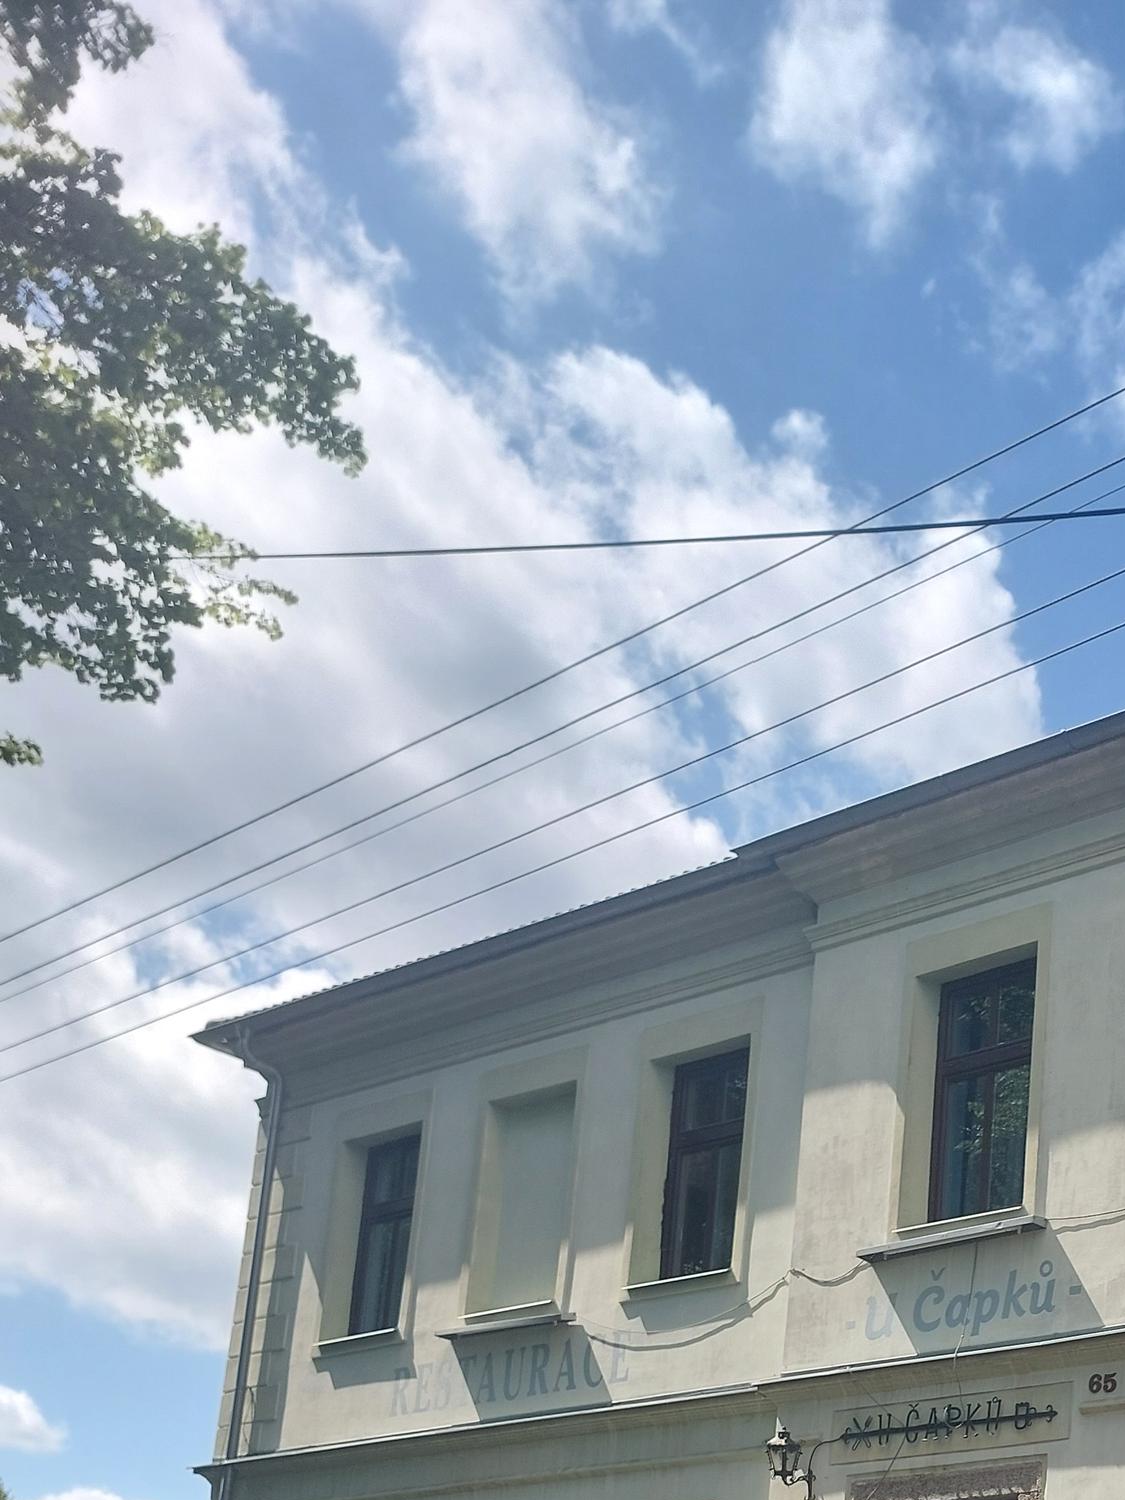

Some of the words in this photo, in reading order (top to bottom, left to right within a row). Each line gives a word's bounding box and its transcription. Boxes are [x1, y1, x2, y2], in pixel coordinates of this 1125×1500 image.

[865, 1292, 897, 1340] U
[912, 1260, 1056, 1337] Čapků
[389, 1329, 629, 1417] RESTAURACE
[1088, 1373, 1117, 1394] 65
